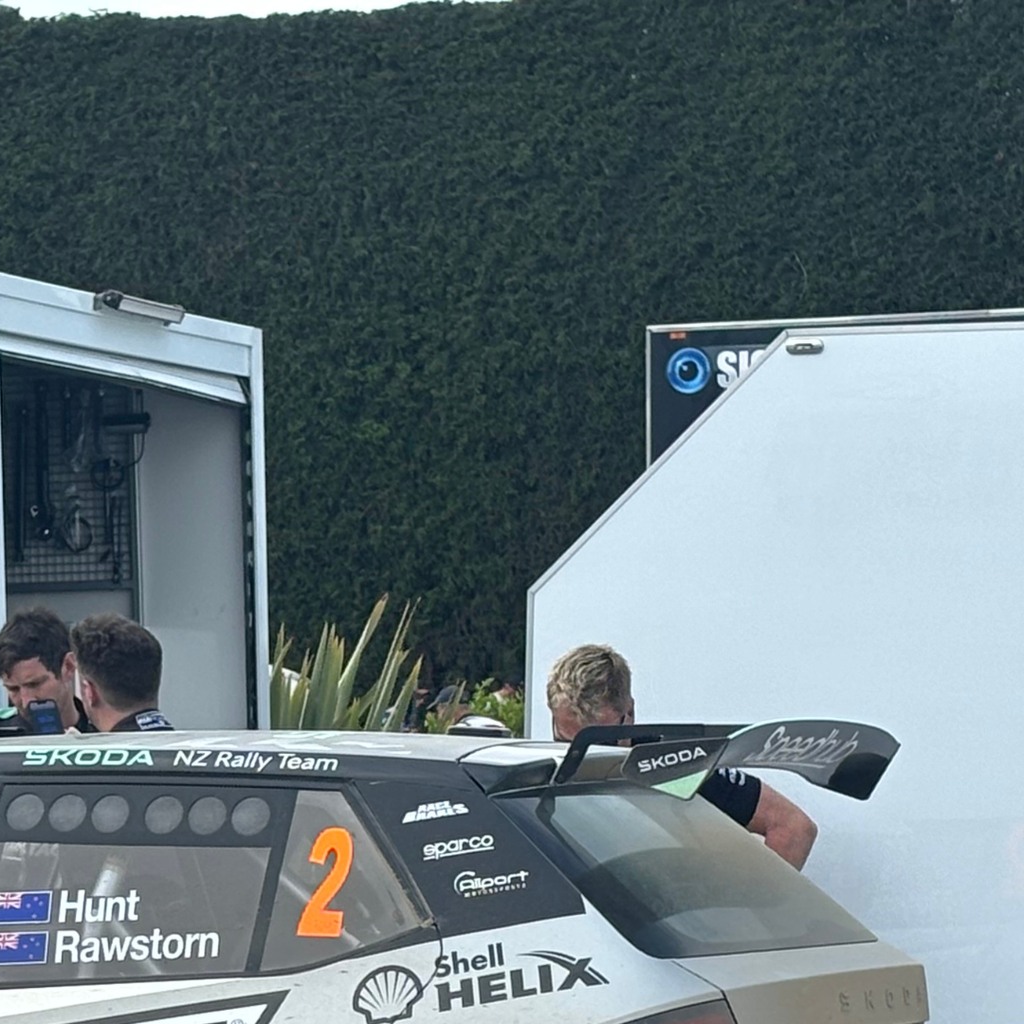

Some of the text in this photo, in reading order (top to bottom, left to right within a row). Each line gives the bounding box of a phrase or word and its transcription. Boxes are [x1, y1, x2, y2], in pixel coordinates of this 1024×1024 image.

[173, 750, 339, 773] NZ Rally Team
[423, 835, 494, 860] sparco
[296, 826, 354, 938] 2
[455, 872, 528, 892] Allport
[59, 889, 141, 922] Hunt
[54, 930, 219, 963] Rawstorn
[435, 942, 505, 977] Shell
[435, 953, 610, 1012] HELIX
